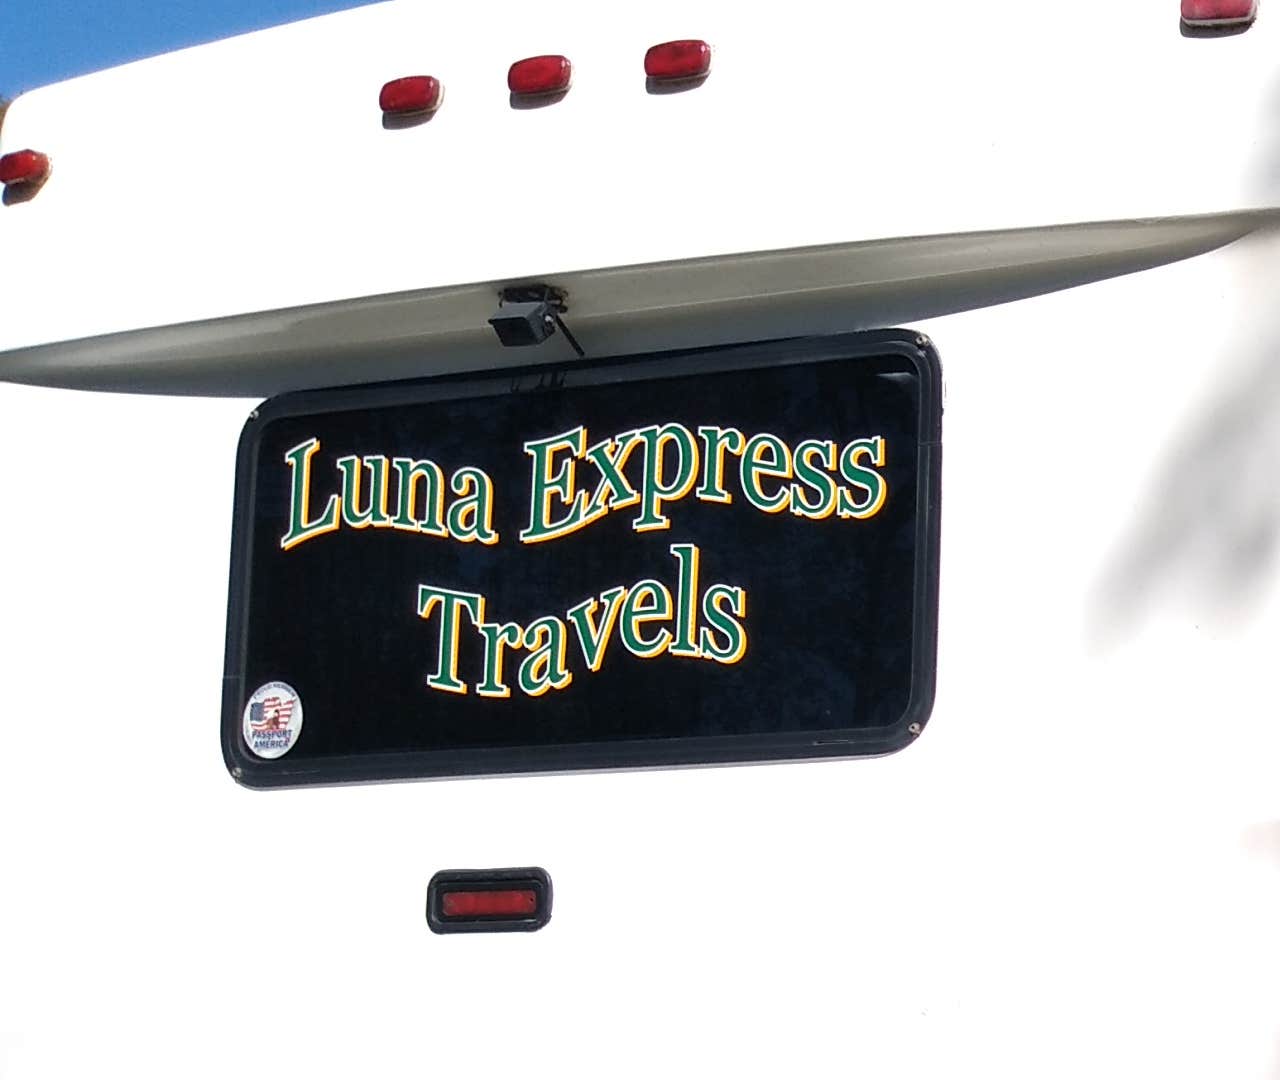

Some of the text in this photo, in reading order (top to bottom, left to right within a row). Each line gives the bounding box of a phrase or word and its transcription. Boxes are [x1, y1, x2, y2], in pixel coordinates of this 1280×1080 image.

[281, 421, 886, 549] Luna Express
[417, 543, 747, 697] Travels
[252, 729, 292, 739] PASSPORT
[254, 740, 288, 748] AMERICA
